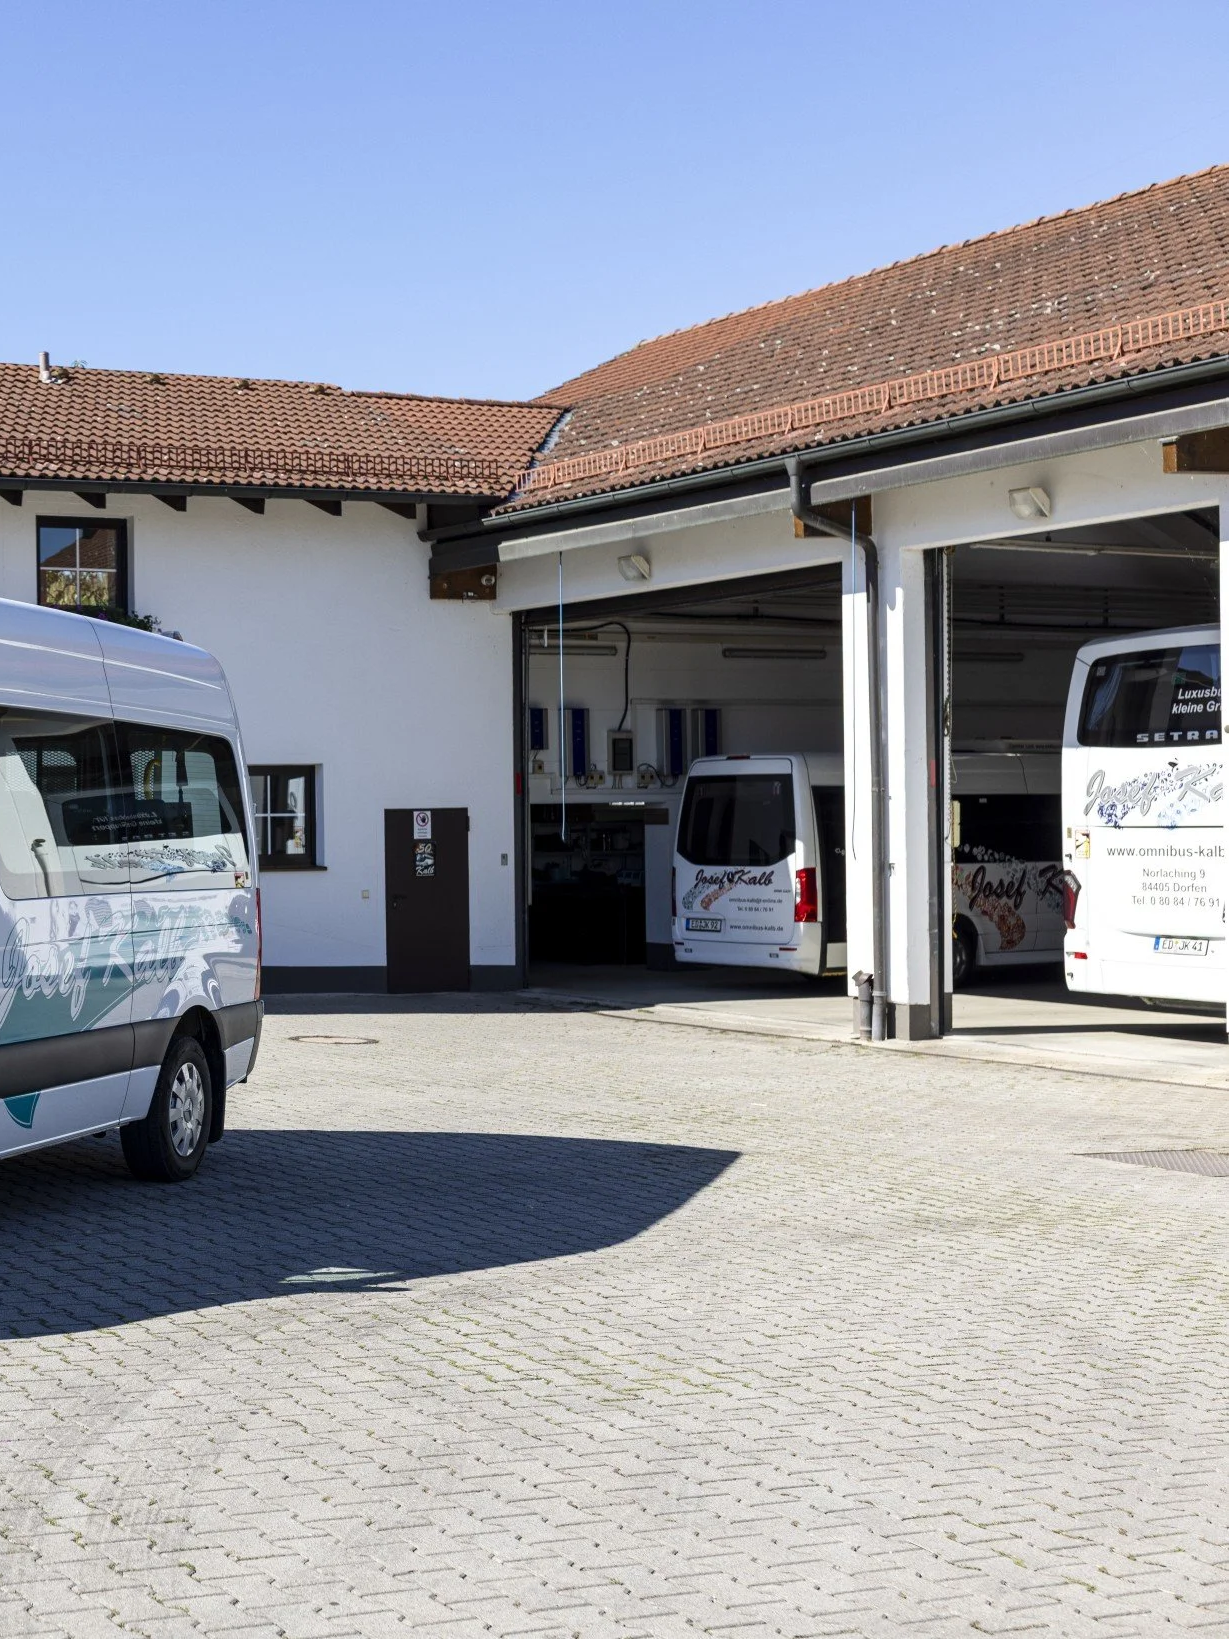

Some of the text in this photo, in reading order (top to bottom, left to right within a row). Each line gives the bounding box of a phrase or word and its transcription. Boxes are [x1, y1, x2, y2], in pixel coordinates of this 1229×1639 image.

[1172, 701, 1222, 714] kleine Gr
[1136, 730, 1219, 743] SETRA
[1083, 769, 1159, 816] Josef
[694, 869, 775, 889] Josef Kalb
[1142, 868, 1206, 881] Norlaching 9
[969, 865, 1027, 911] Josef
[1141, 882, 1207, 893] 84405 Dorfen
[1162, 939, 1202, 951] ED JK 41
